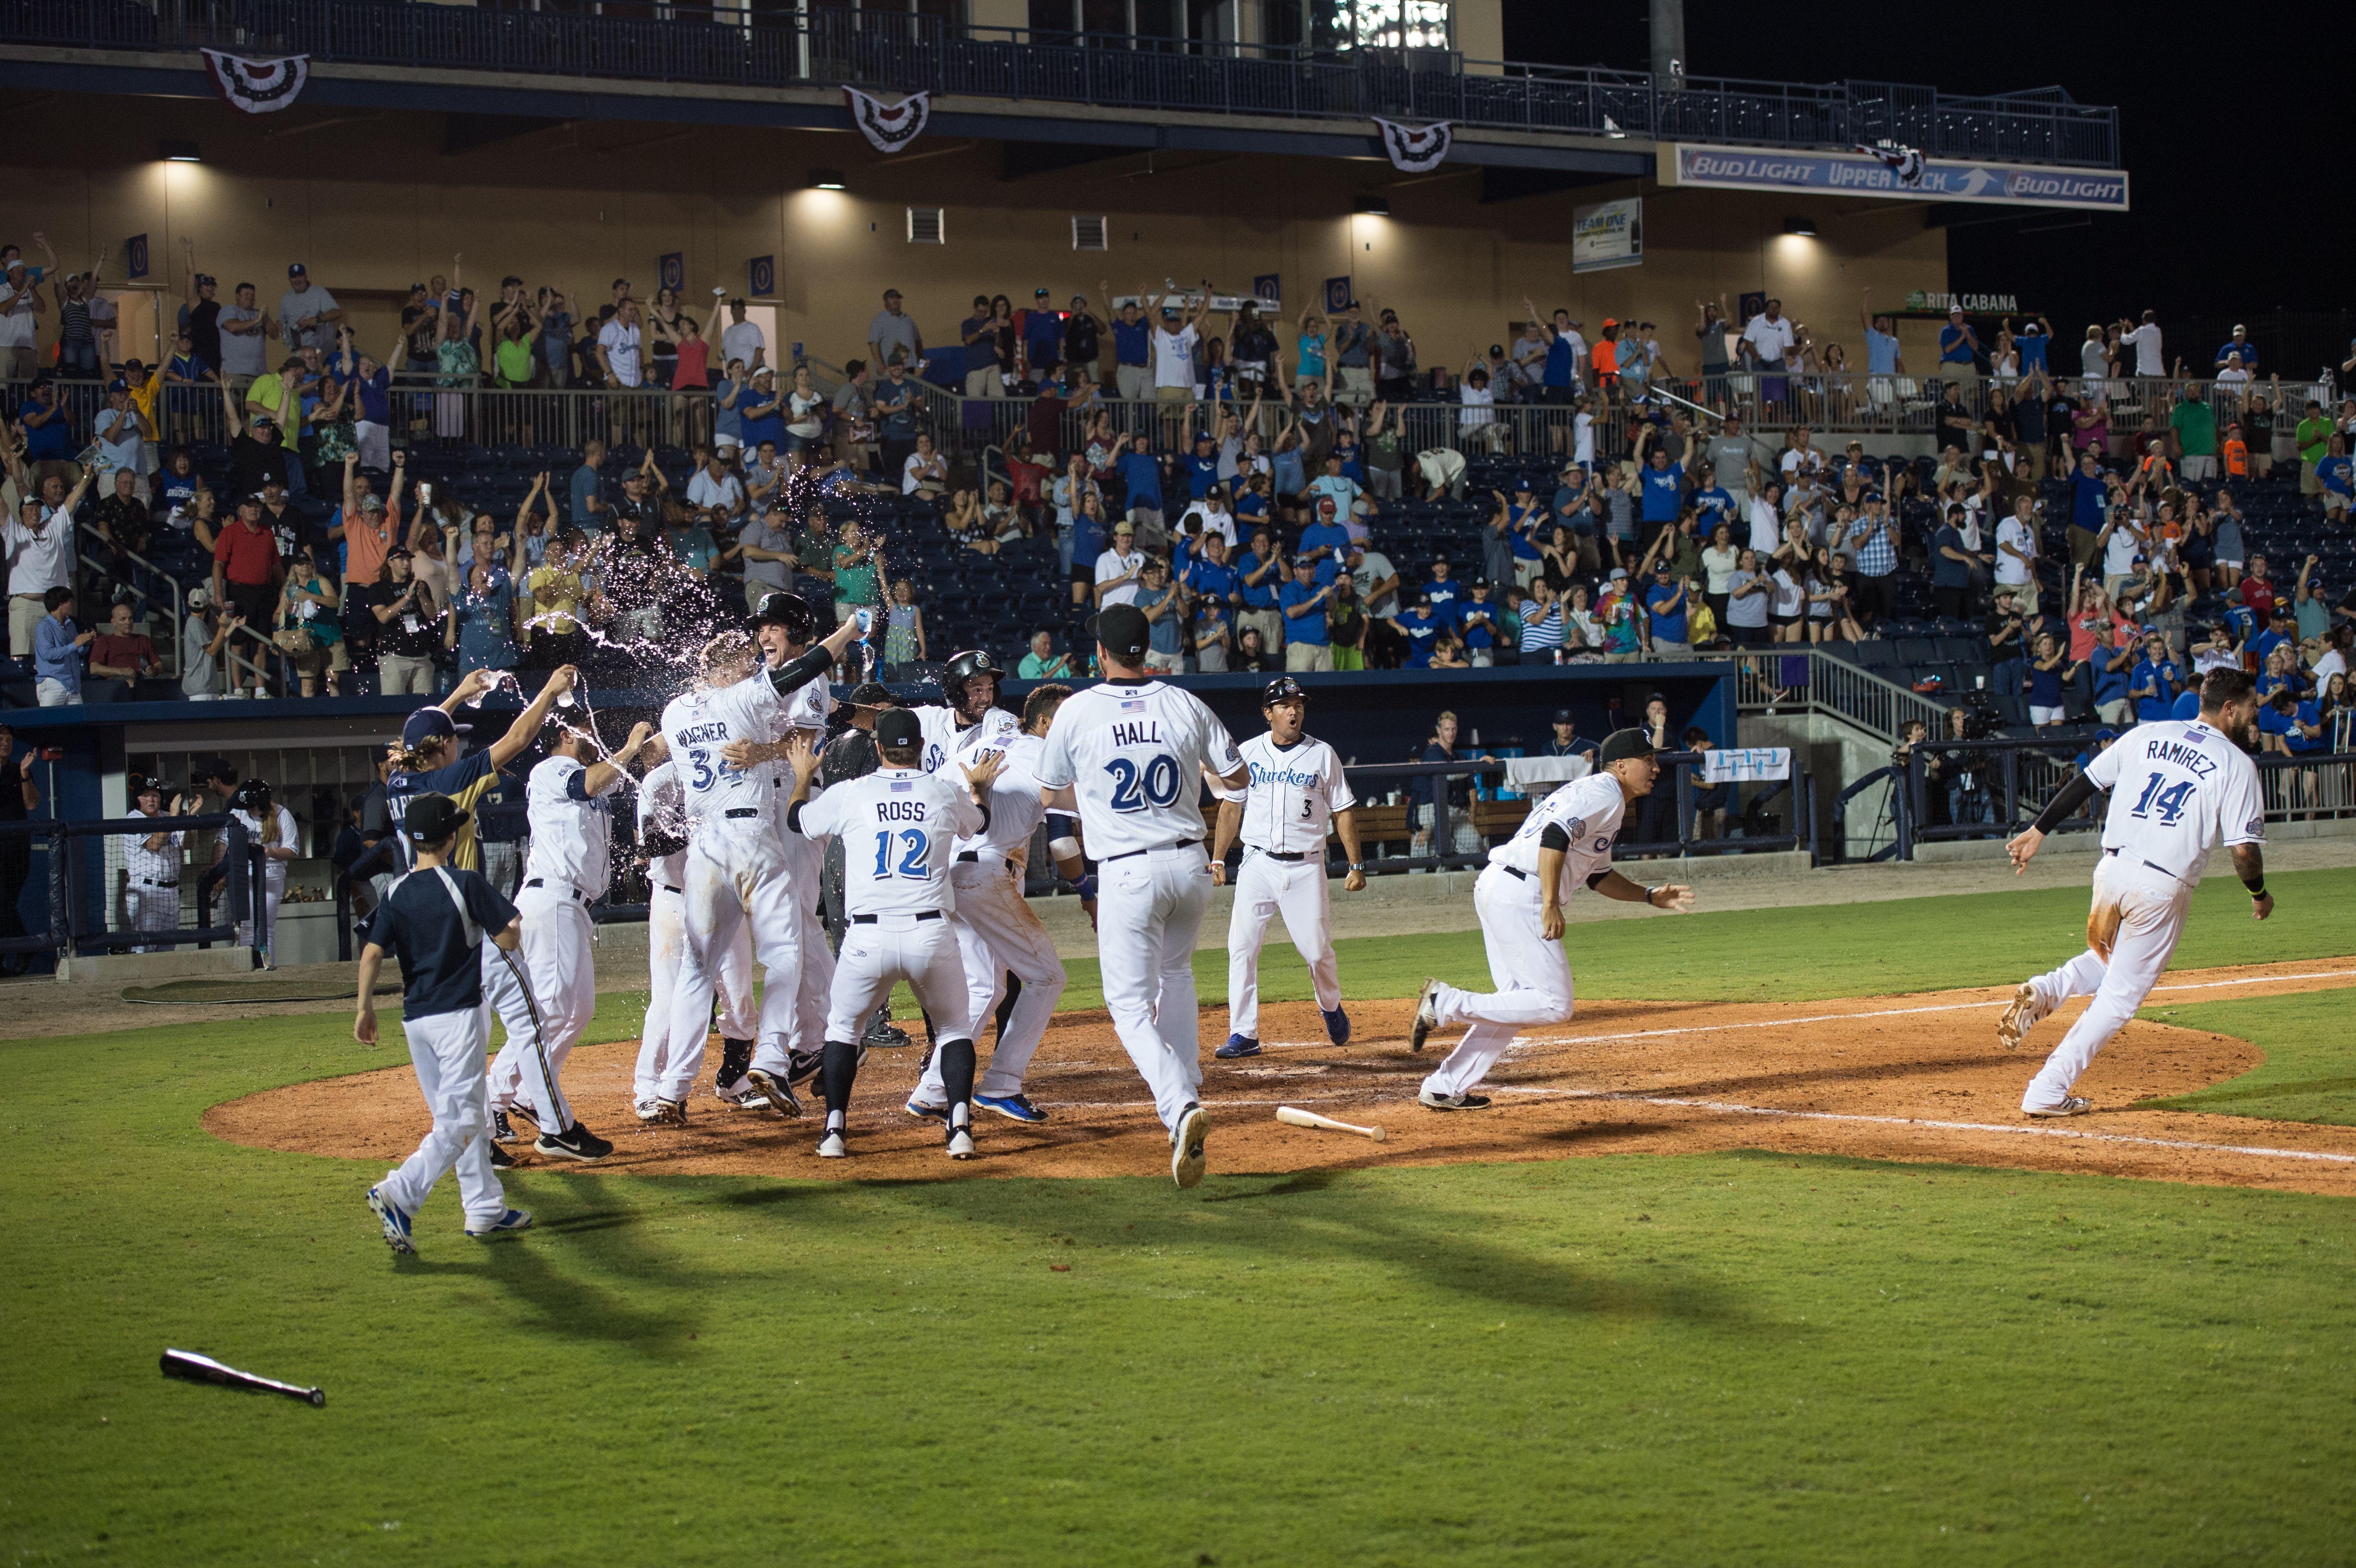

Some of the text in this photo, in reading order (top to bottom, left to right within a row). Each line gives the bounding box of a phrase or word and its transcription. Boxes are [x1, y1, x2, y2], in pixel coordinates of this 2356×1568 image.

[1693, 156, 1815, 181] BUD LIGHT
[1829, 163, 1948, 191] UPPER DCK
[2014, 175, 2123, 199] BUD LIGHT
[1926, 292, 1958, 309] RITA
[1963, 294, 2018, 311] CABANA
[676, 722, 731, 748] WAGNER
[1112, 721, 1162, 747] HALL
[2147, 740, 2217, 780] RAMIREZ
[1103, 753, 1183, 814] 20
[1248, 762, 1319, 789] Shuckers
[876, 802, 926, 822] ROSS
[1301, 799, 1313, 819] 3
[2131, 772, 2197, 827] 14
[873, 828, 931, 881] 12
